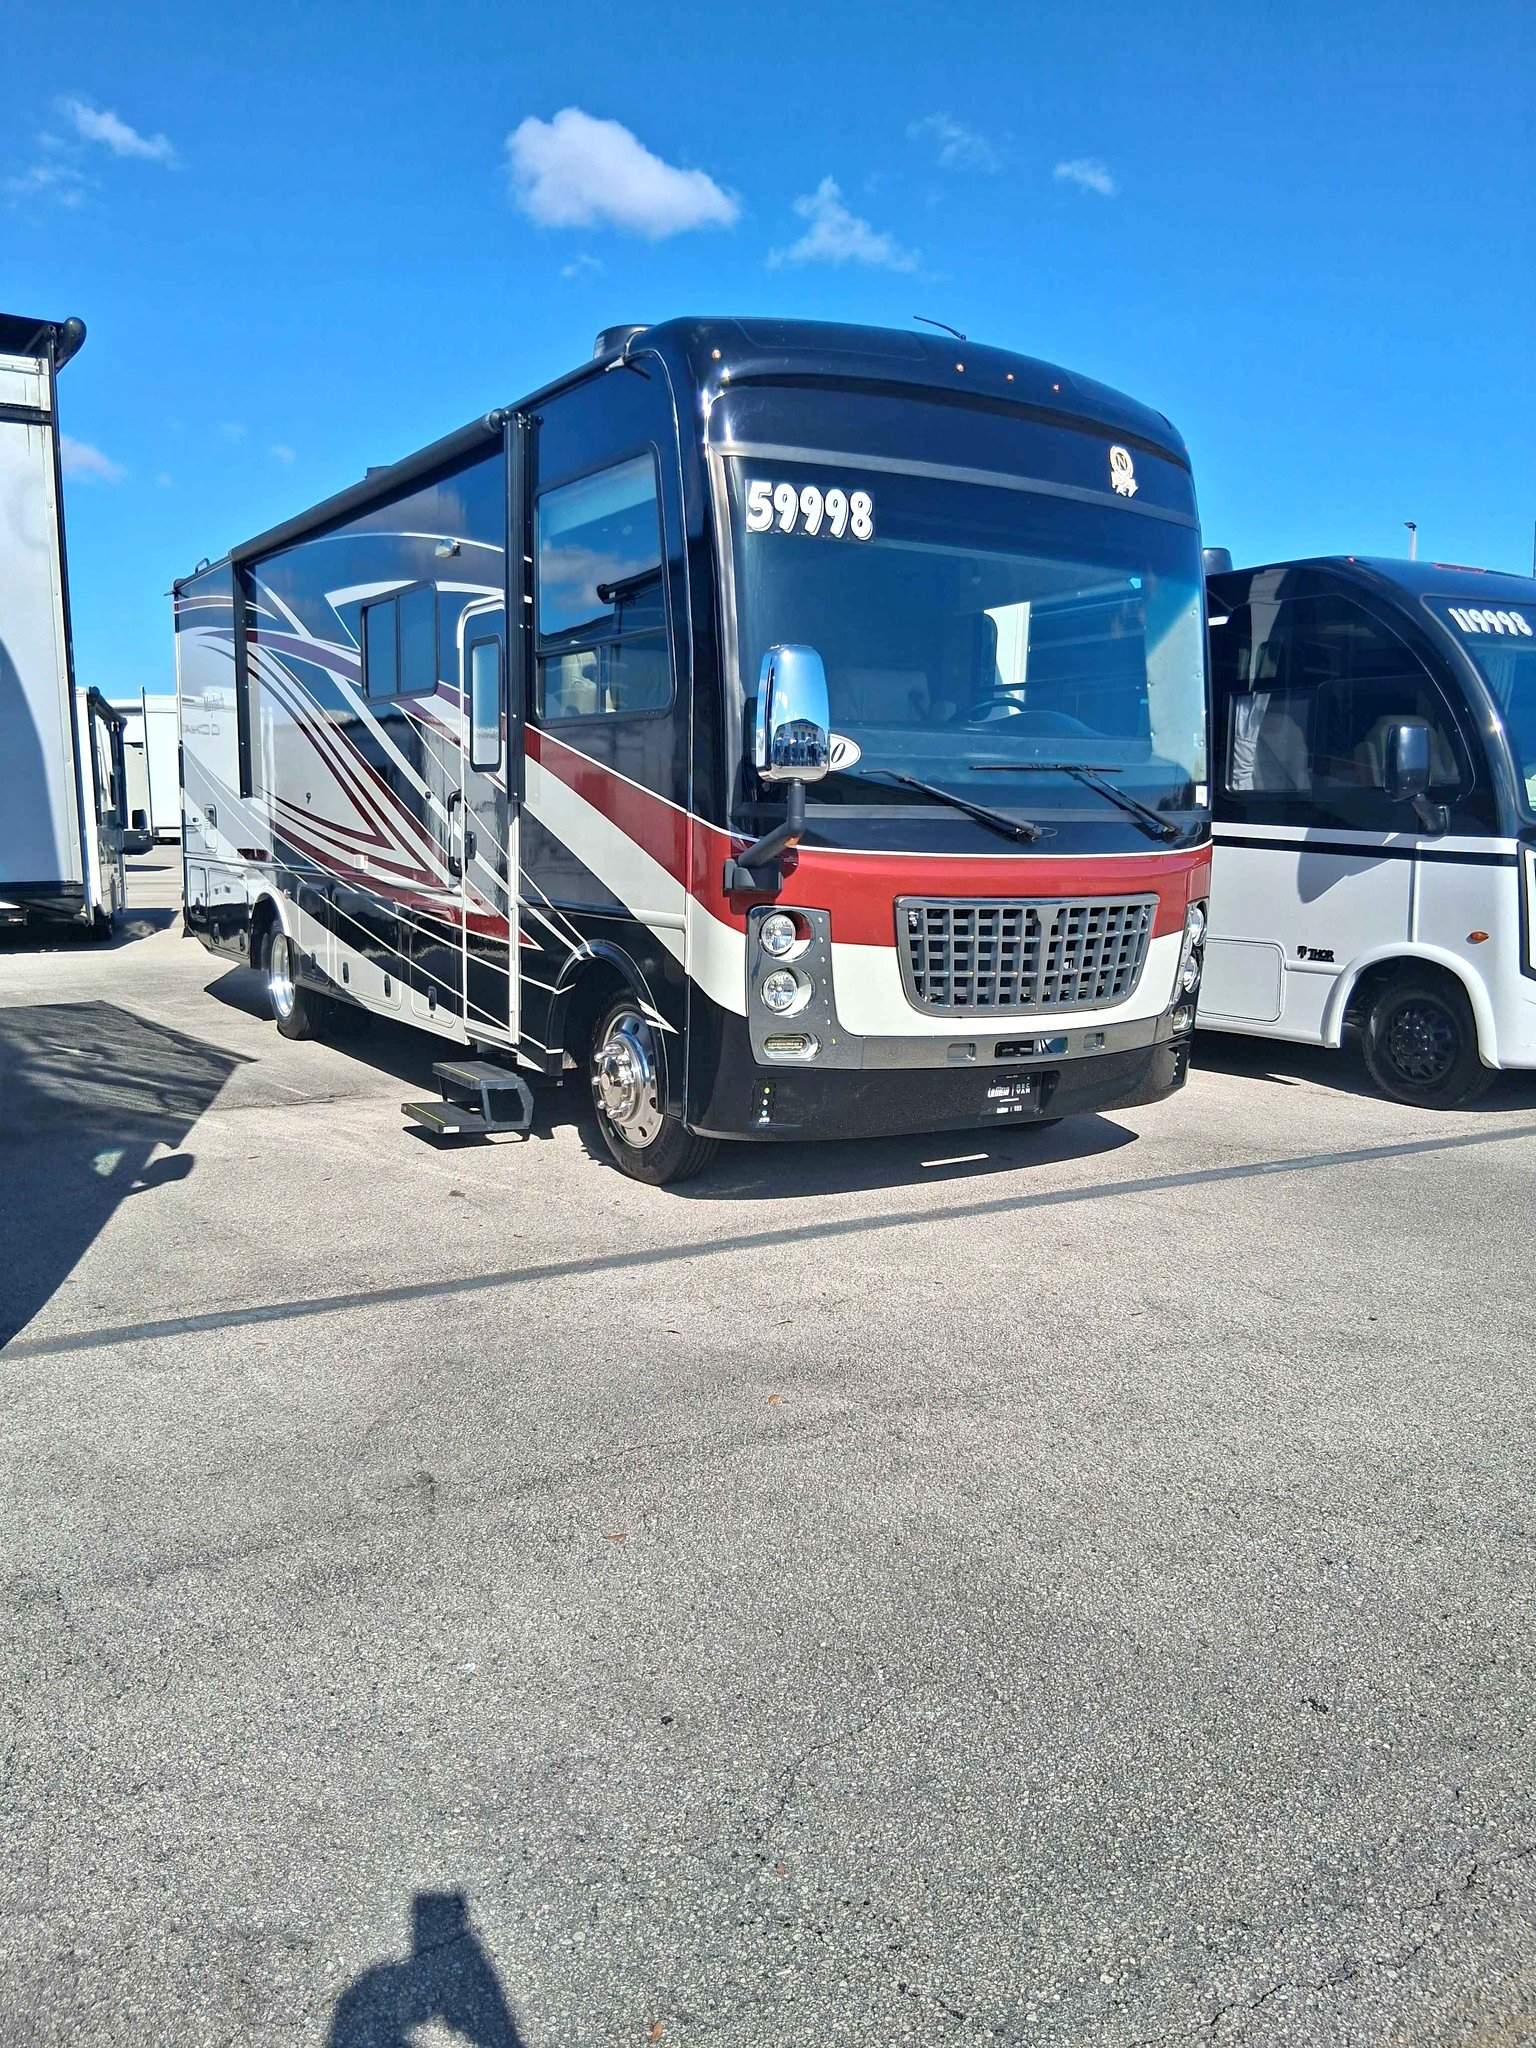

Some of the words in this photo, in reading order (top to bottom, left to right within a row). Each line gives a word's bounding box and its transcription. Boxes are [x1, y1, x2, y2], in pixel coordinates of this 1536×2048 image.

[746, 481, 873, 541] 59998
[1448, 608, 1533, 636] 119998
[1306, 947, 1335, 962] THOR
